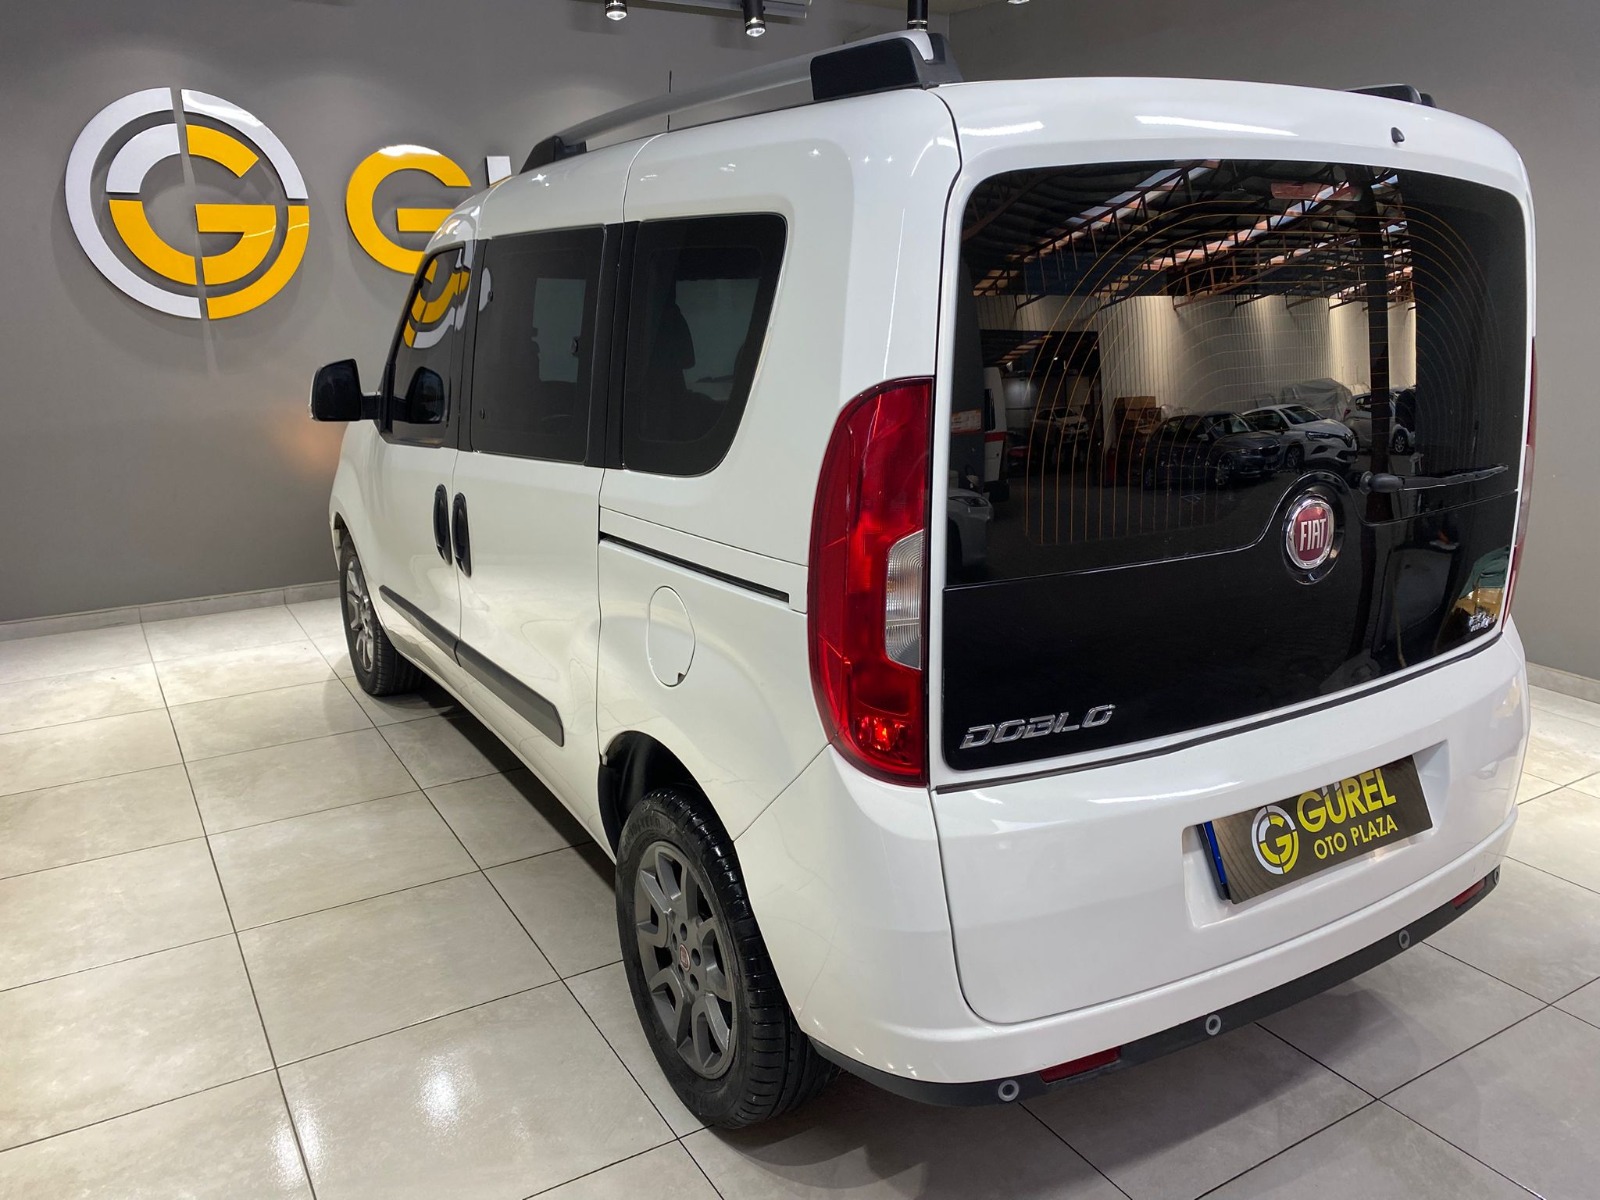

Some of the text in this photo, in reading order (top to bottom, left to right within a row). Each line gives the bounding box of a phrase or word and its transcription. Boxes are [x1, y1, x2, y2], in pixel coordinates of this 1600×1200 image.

[1300, 518, 1326, 552] FIAT
[1313, 814, 1398, 861] OTO PLAZA
